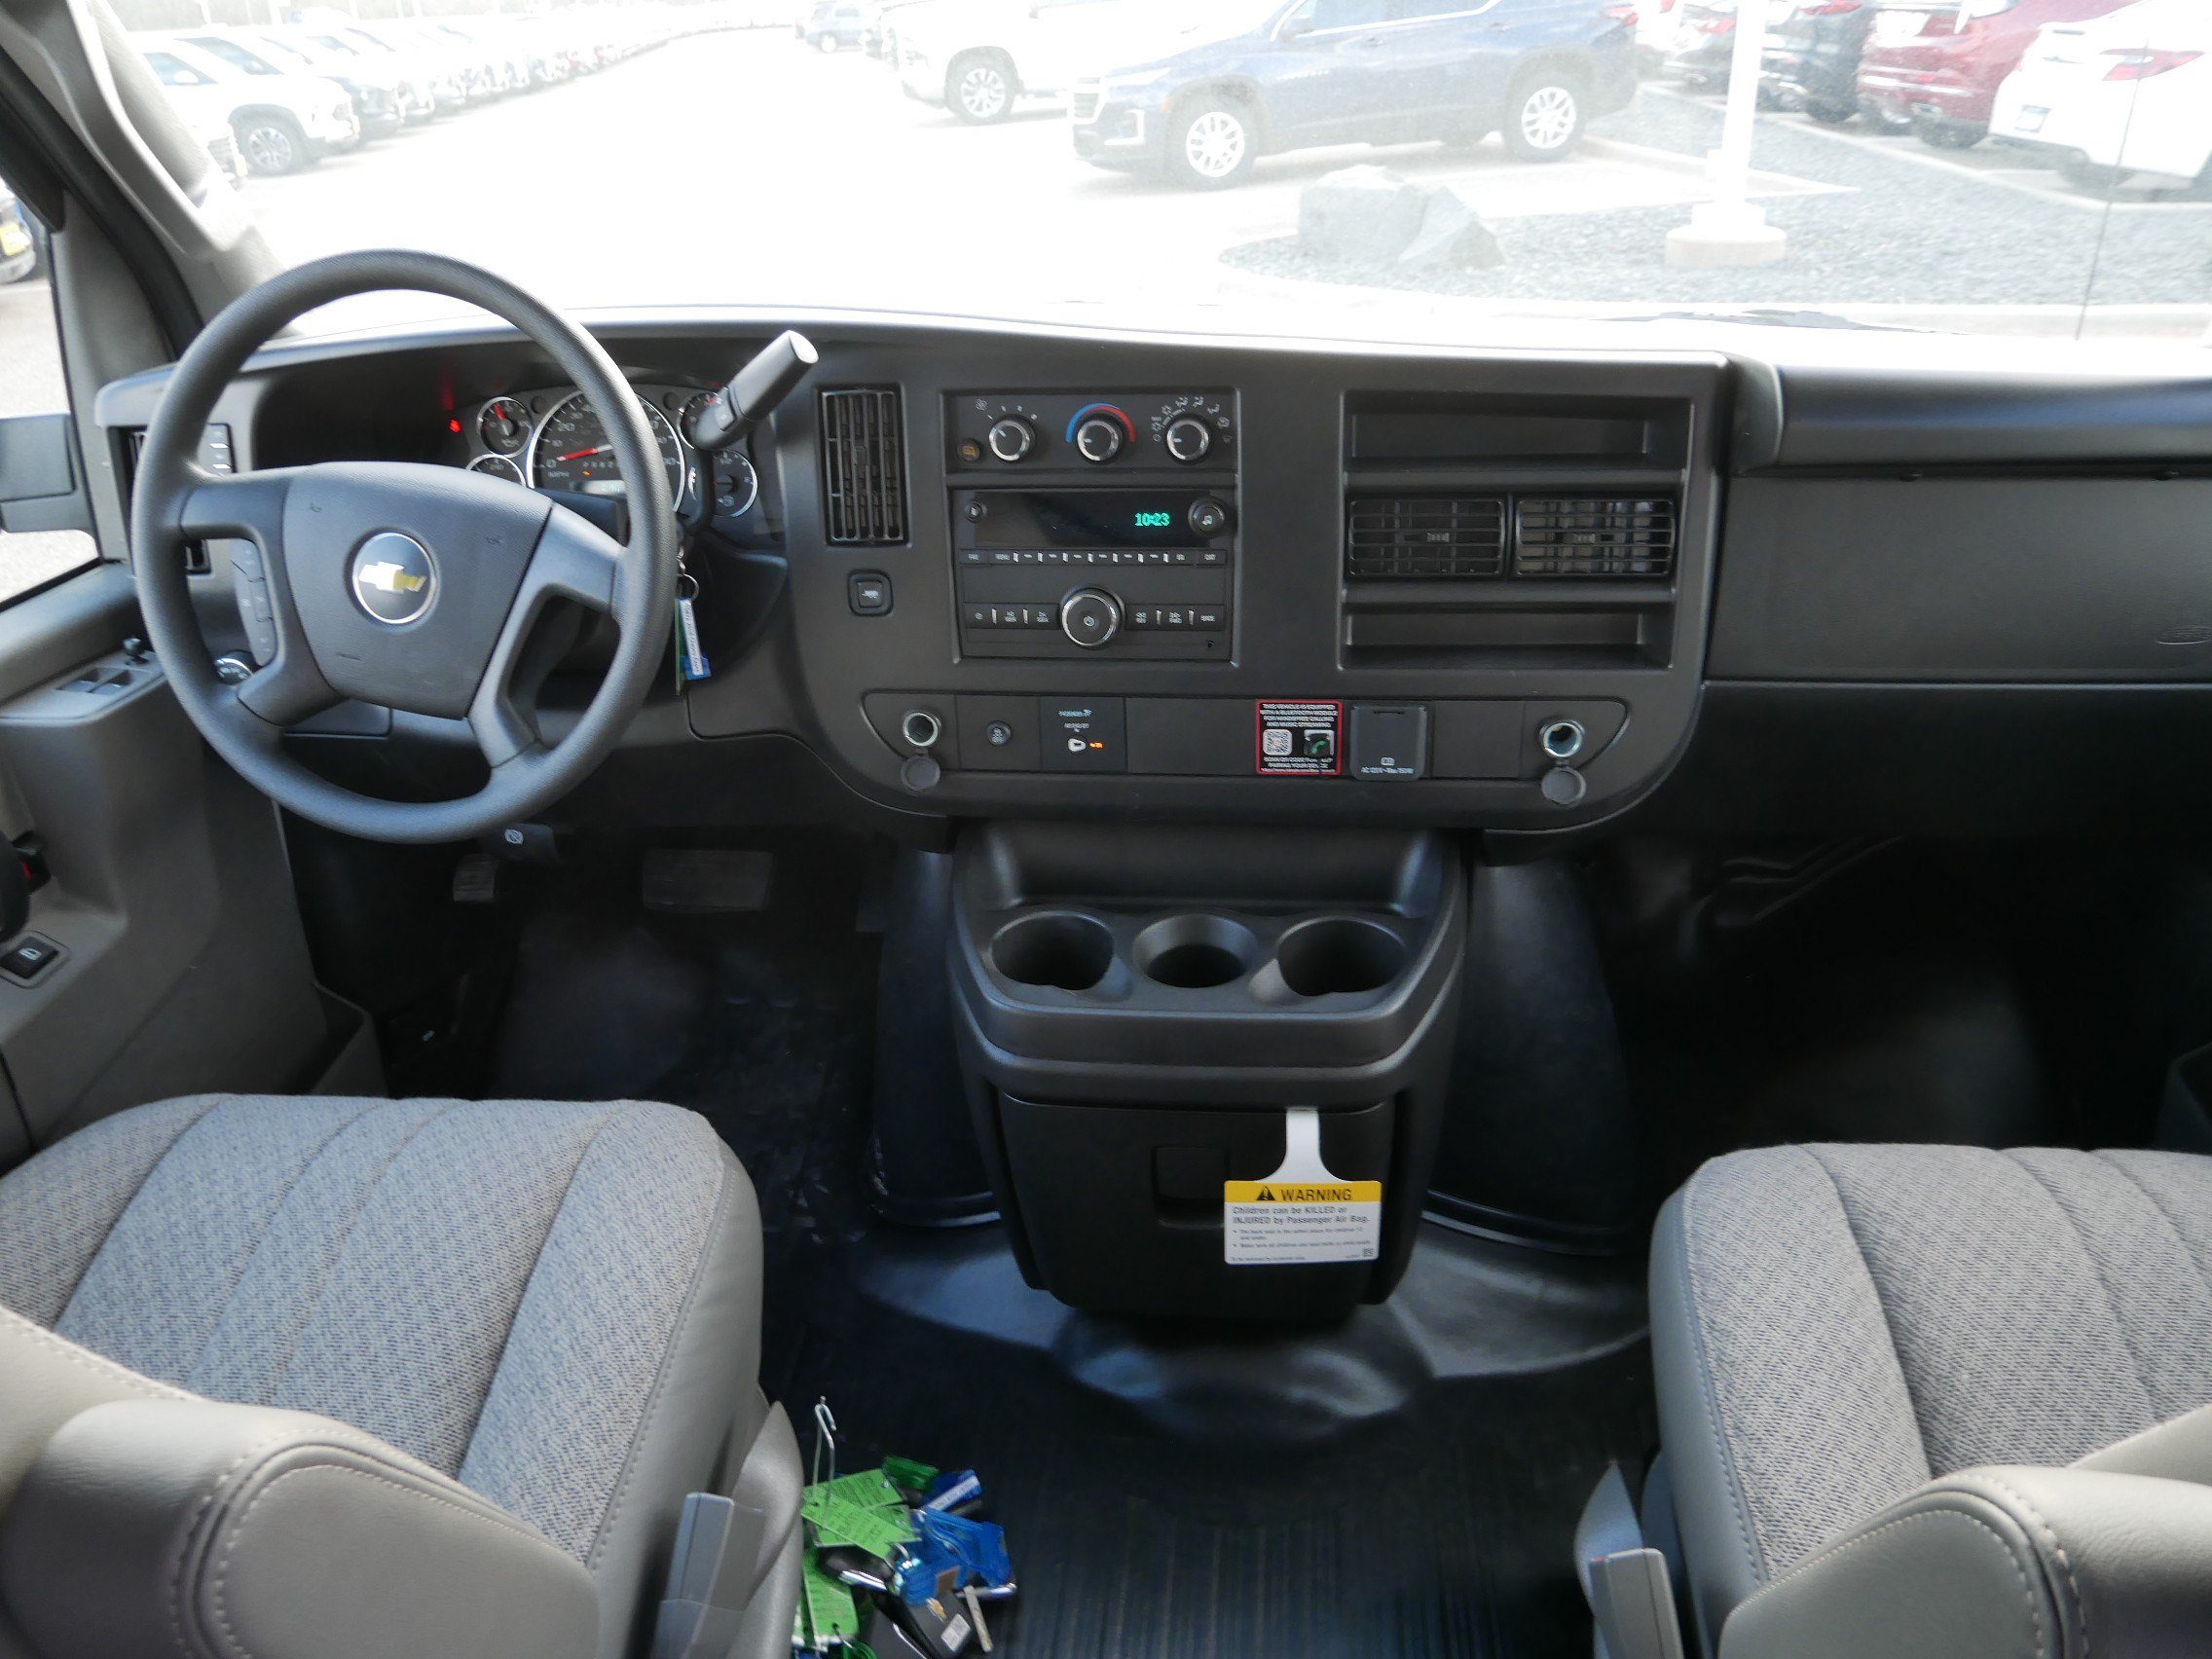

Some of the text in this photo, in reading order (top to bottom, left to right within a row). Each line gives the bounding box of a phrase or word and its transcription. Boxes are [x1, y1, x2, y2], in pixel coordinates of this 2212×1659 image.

[1134, 512, 1171, 527] 10:23
[1280, 1188, 1352, 1201] WARNING
[1304, 1205, 1335, 1214] KILLED
[1273, 1216, 1283, 1225] by
[1287, 1216, 1333, 1225] Passenger
